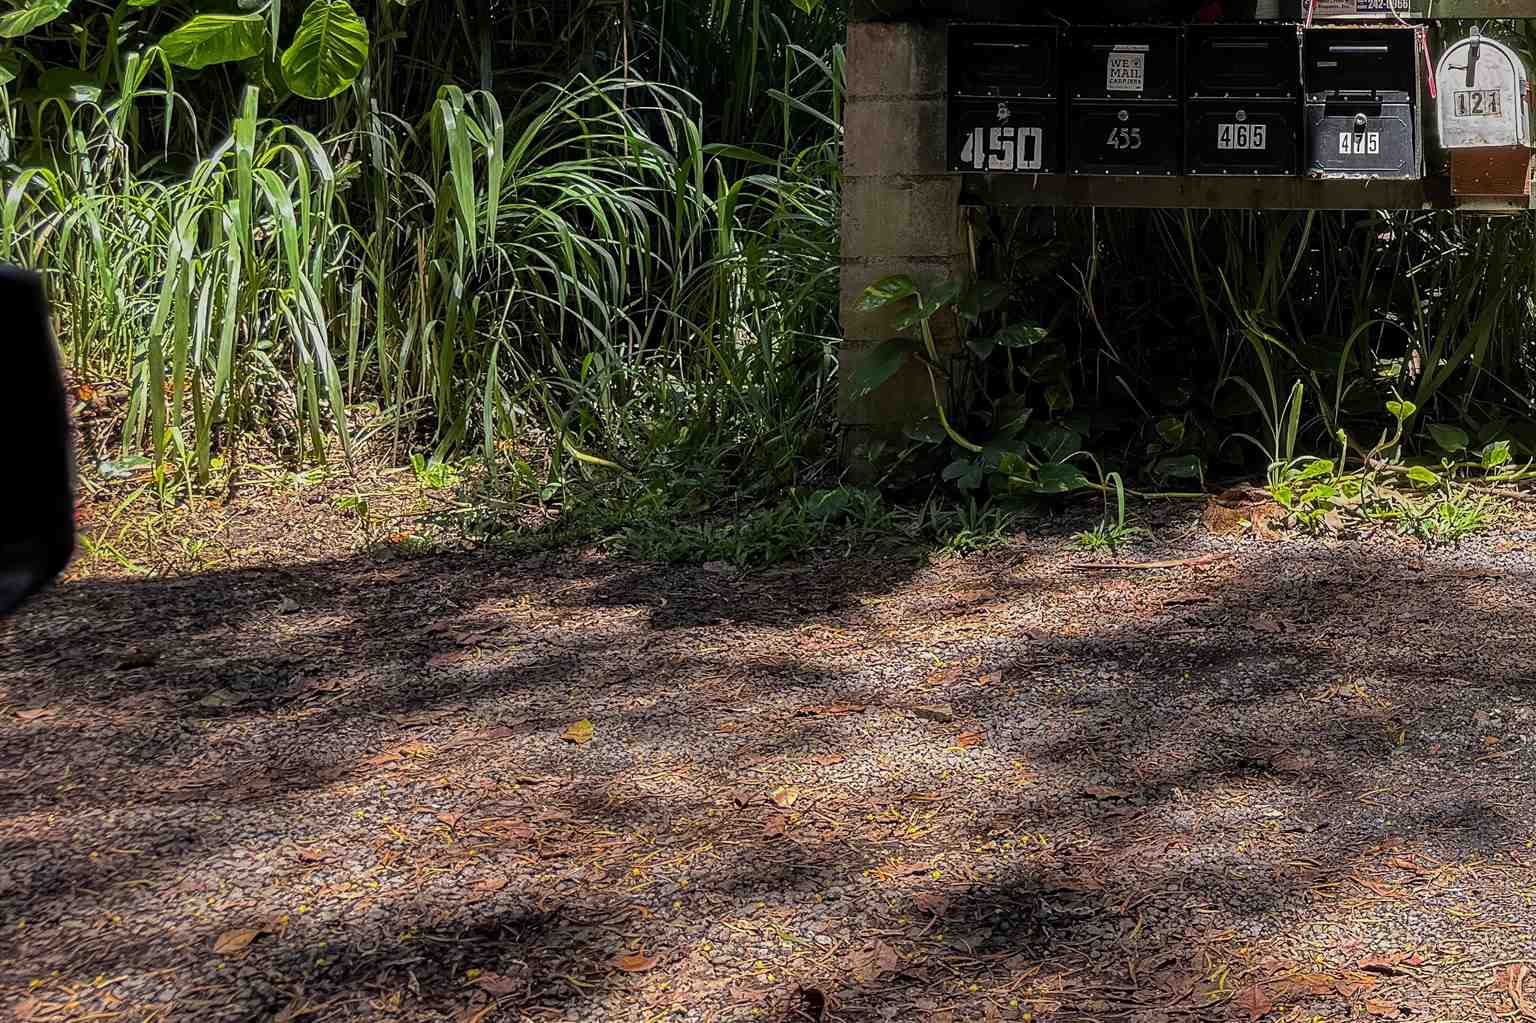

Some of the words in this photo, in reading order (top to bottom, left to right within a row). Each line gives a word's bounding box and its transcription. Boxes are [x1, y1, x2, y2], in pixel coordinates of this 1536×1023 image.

[1106, 127, 1141, 149] 455
[1221, 126, 1263, 147] 465
[1342, 134, 1377, 152] 475
[960, 127, 1042, 170] 450
